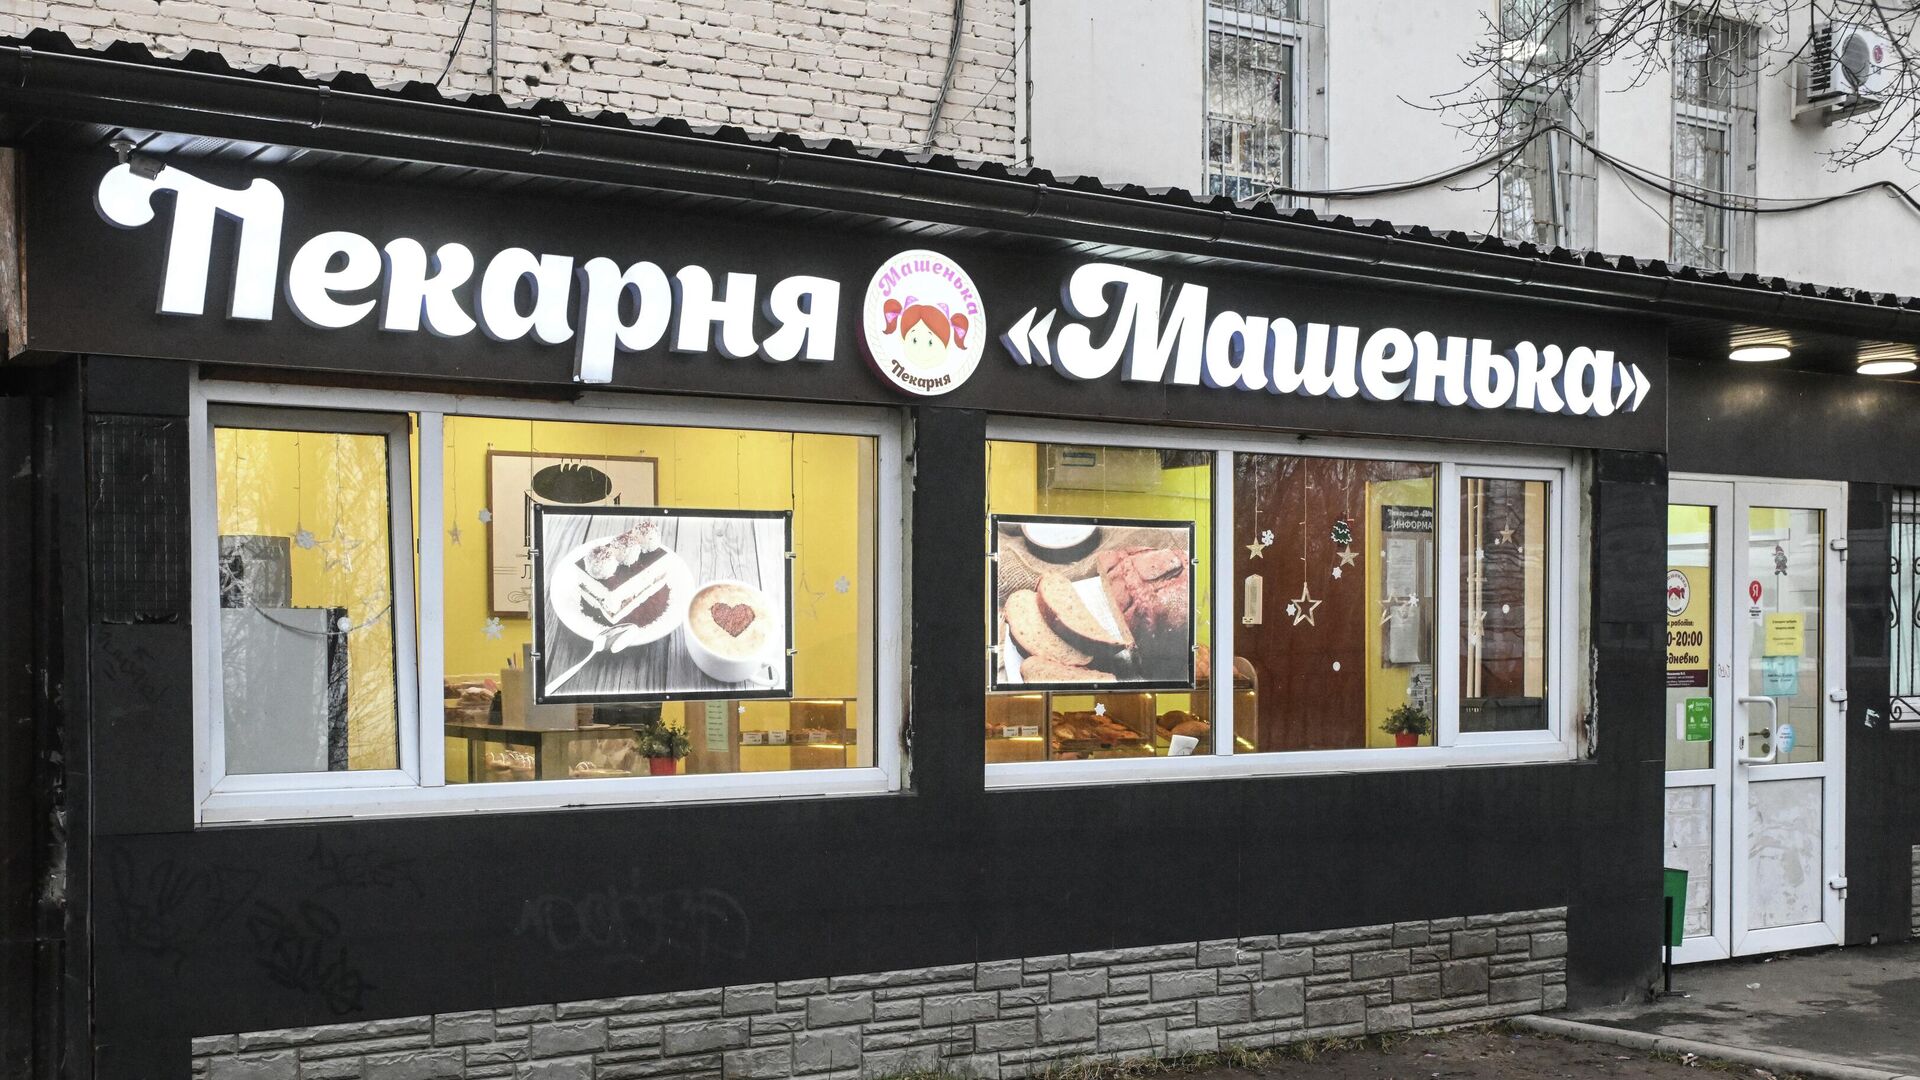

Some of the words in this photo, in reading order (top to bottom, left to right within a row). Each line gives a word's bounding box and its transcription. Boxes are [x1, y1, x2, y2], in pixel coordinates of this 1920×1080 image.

[97, 162, 841, 384] Пекарня
[1002, 262, 1651, 417] «Машенька»
[878, 260, 979, 316] Машенька
[891, 359, 951, 391] Пекарня
